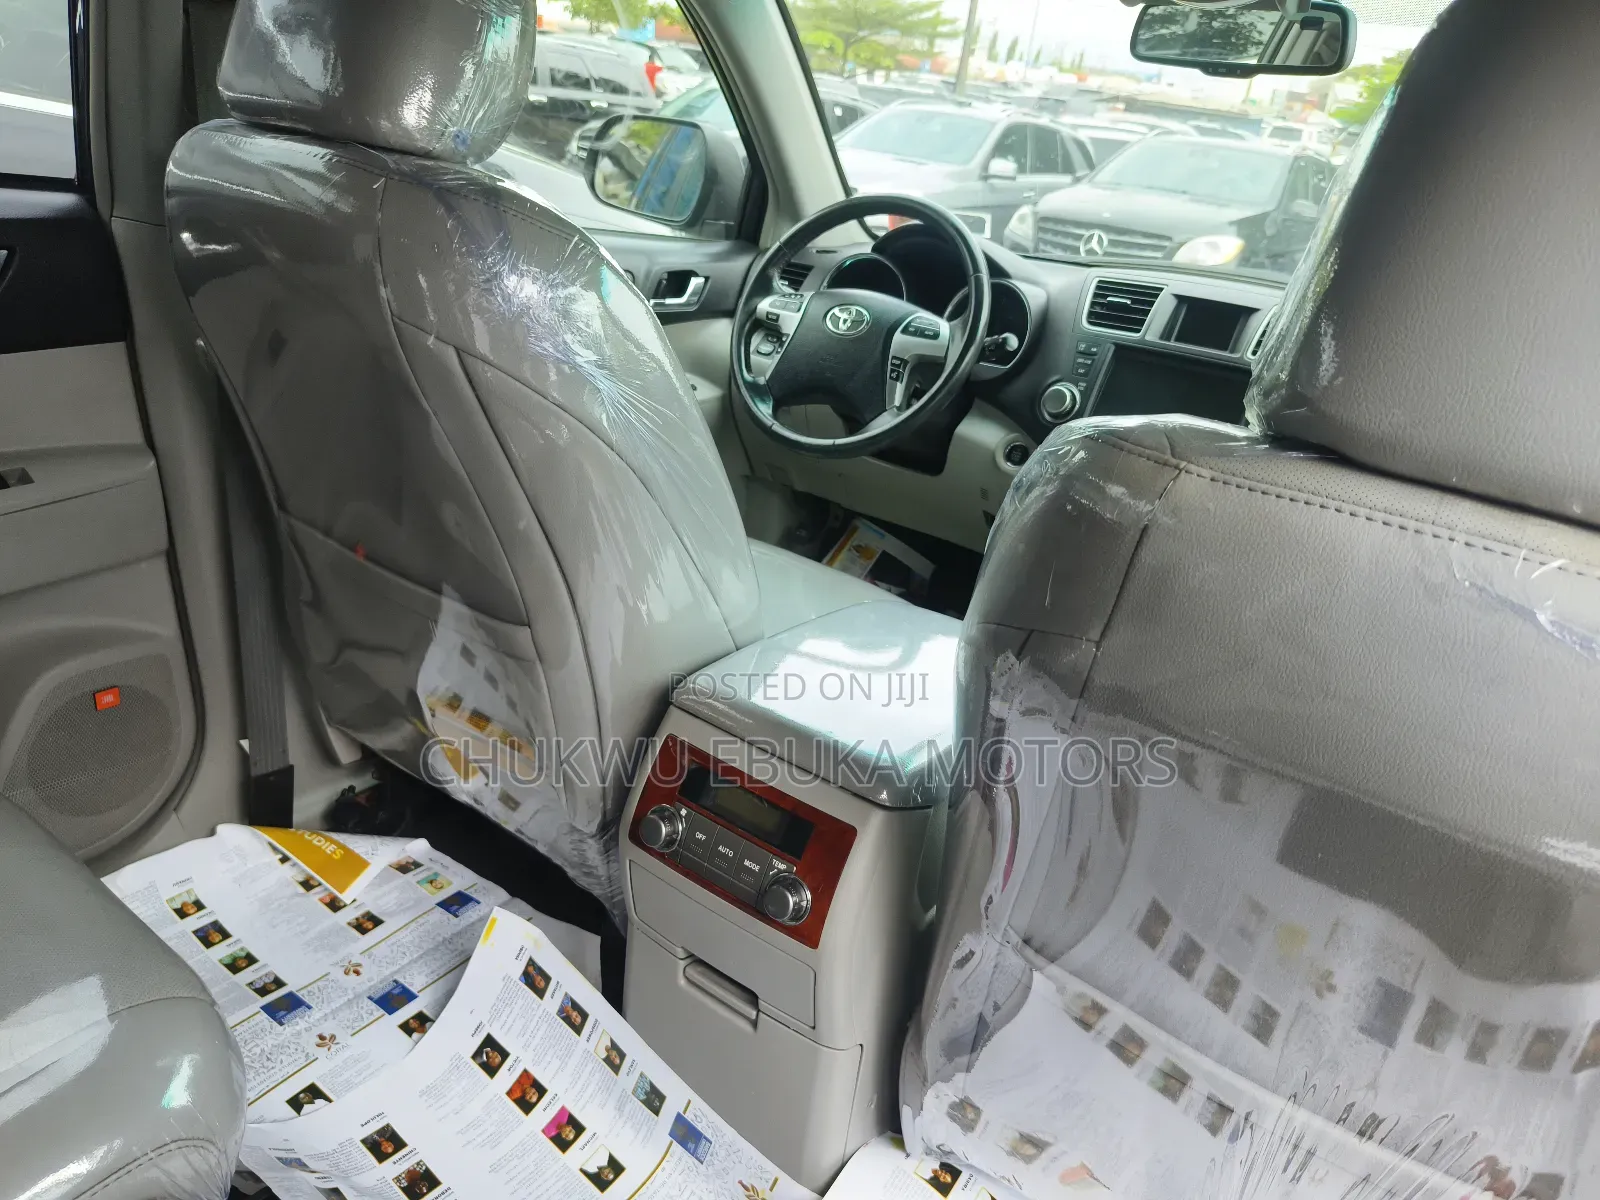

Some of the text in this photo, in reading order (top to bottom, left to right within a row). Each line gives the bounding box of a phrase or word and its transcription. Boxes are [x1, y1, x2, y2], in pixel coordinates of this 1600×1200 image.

[695, 831, 706, 841] OFF
[717, 844, 734, 857] AUTO
[743, 858, 761, 872] MODE
[772, 858, 787, 870] TEMP
